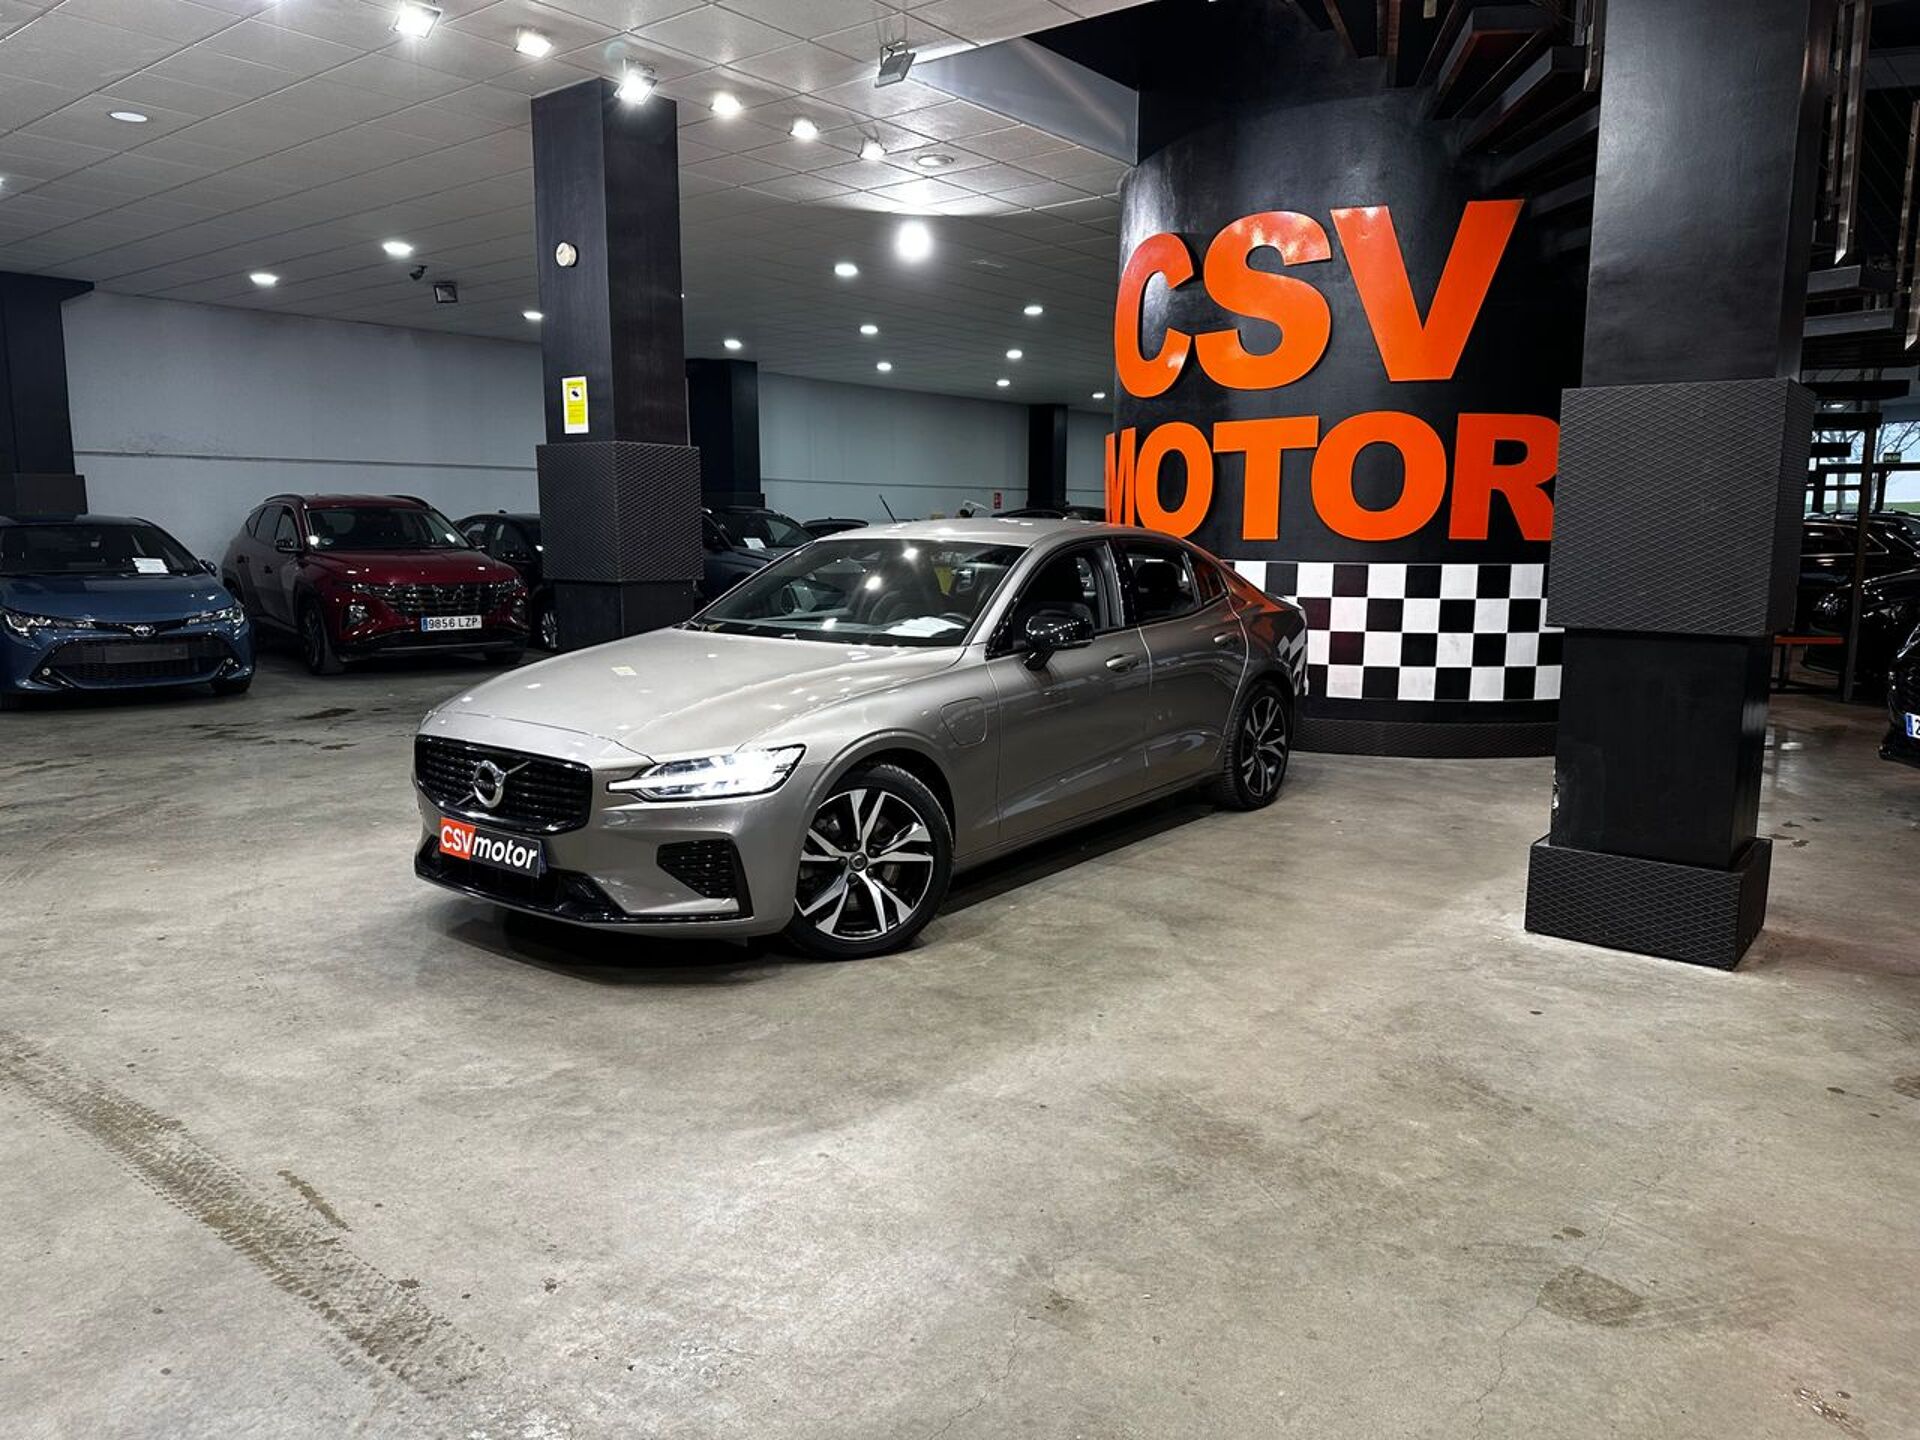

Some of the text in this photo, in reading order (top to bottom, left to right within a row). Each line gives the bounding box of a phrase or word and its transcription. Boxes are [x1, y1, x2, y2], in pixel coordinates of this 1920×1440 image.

[1113, 199, 1525, 398] CSV
[1104, 410, 1561, 542] MOTOR
[428, 616, 478, 629] 9856 LZP
[441, 825, 538, 870] CSVmotor
